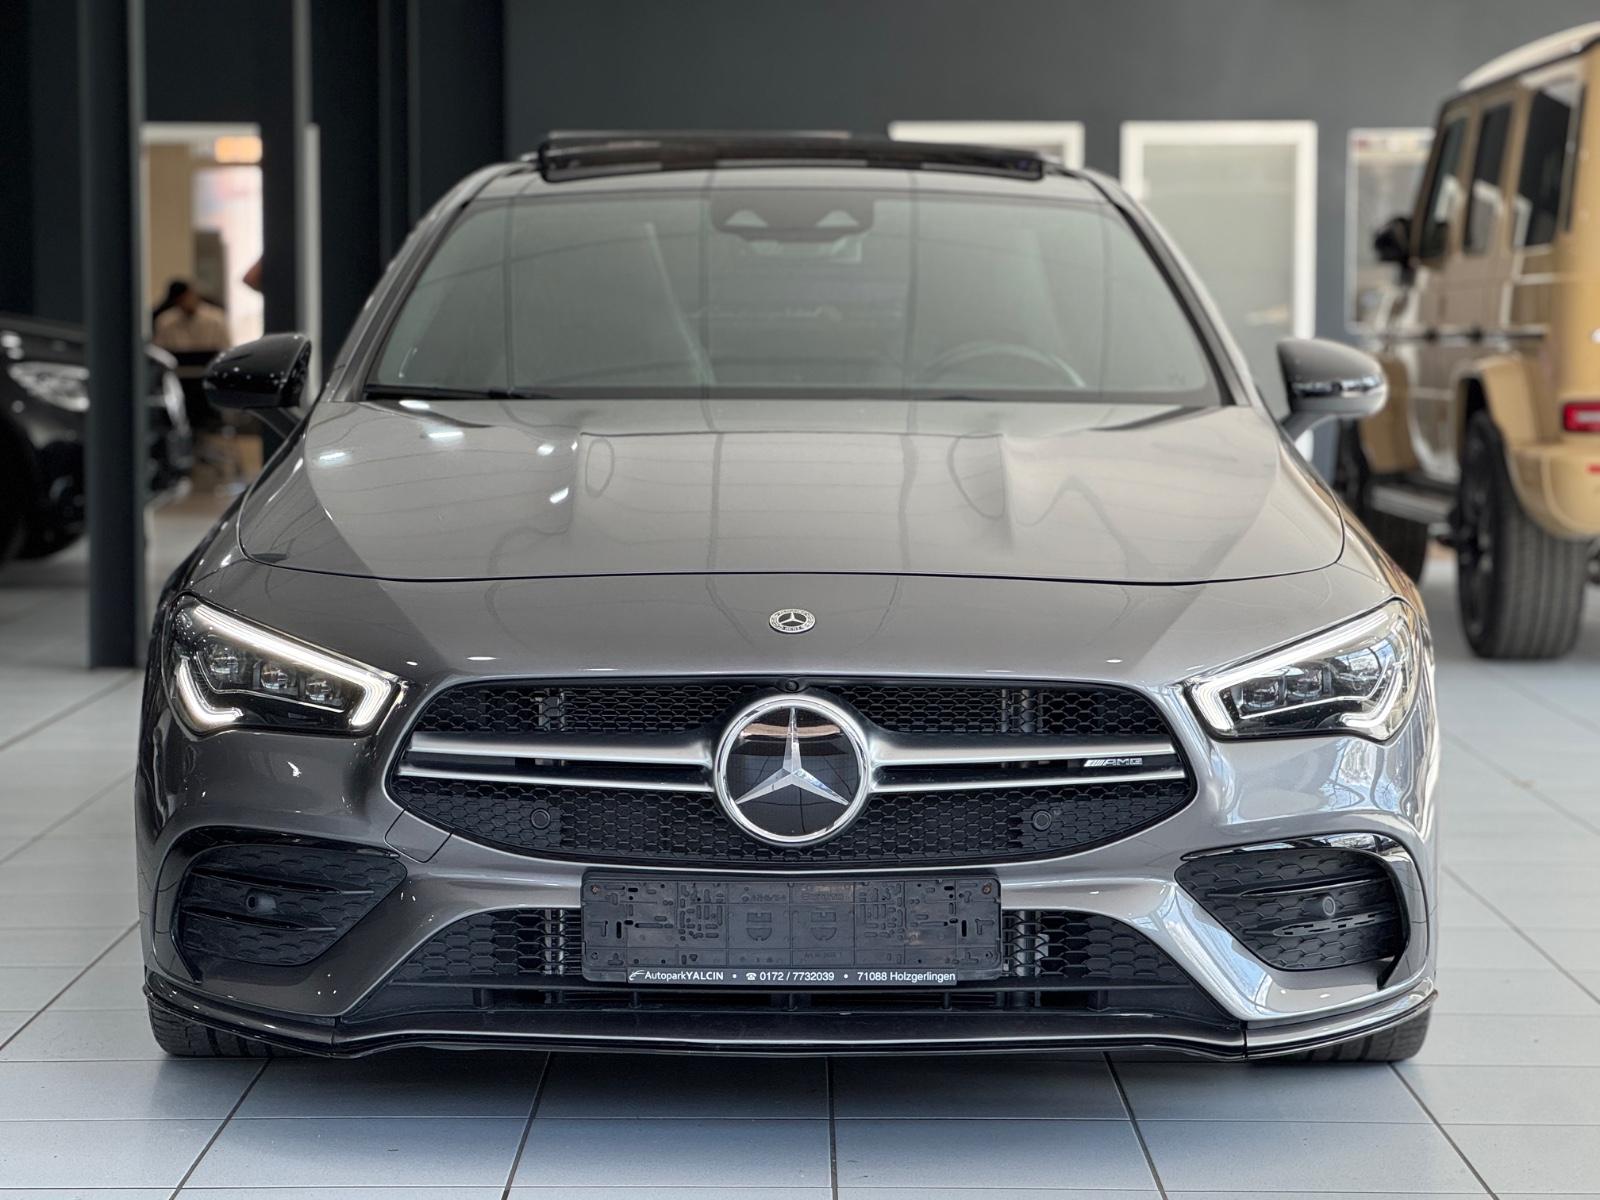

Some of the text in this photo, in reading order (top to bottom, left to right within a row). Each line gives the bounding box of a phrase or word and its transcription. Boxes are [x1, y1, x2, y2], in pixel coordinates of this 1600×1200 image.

[1103, 757, 1143, 767] AMG
[644, 971, 724, 982] AutoparkYALCIN
[759, 971, 784, 981] 0172
[792, 971, 835, 981] 7732039
[857, 971, 888, 981] 71088
[889, 971, 956, 983] Holzgerlingen
